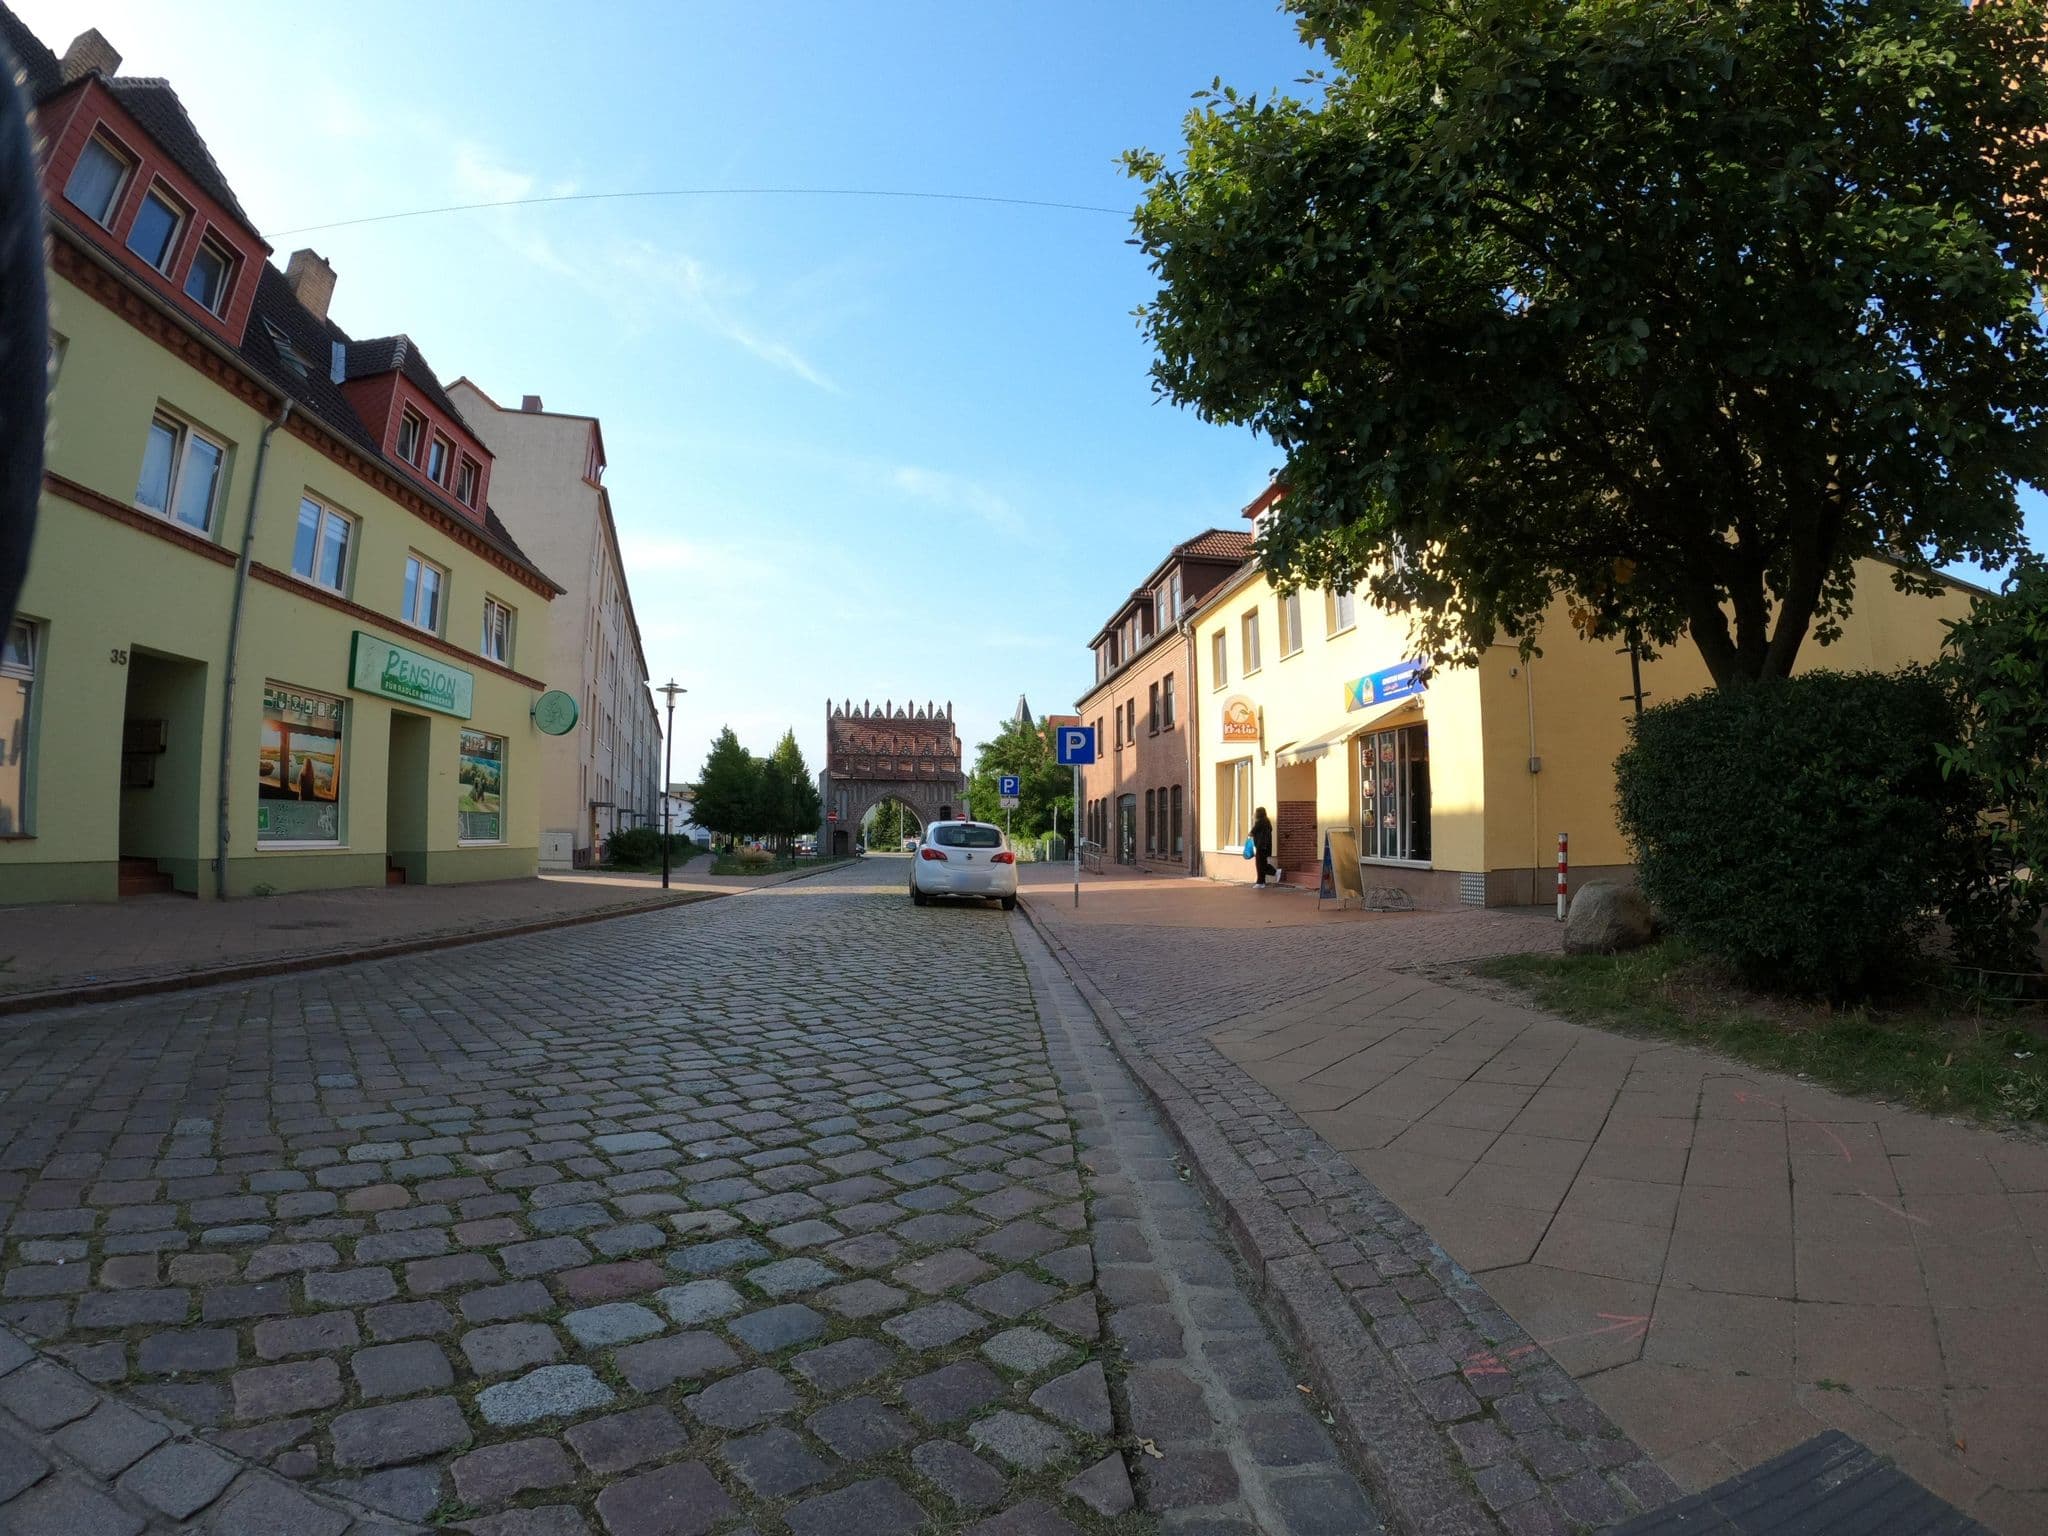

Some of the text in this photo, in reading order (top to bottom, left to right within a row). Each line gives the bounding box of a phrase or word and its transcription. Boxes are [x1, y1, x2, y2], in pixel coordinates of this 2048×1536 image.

[110, 649, 127, 665] 35
[384, 650, 456, 696] PENSION
[1066, 732, 1086, 760] P
[1004, 779, 1014, 793] P
